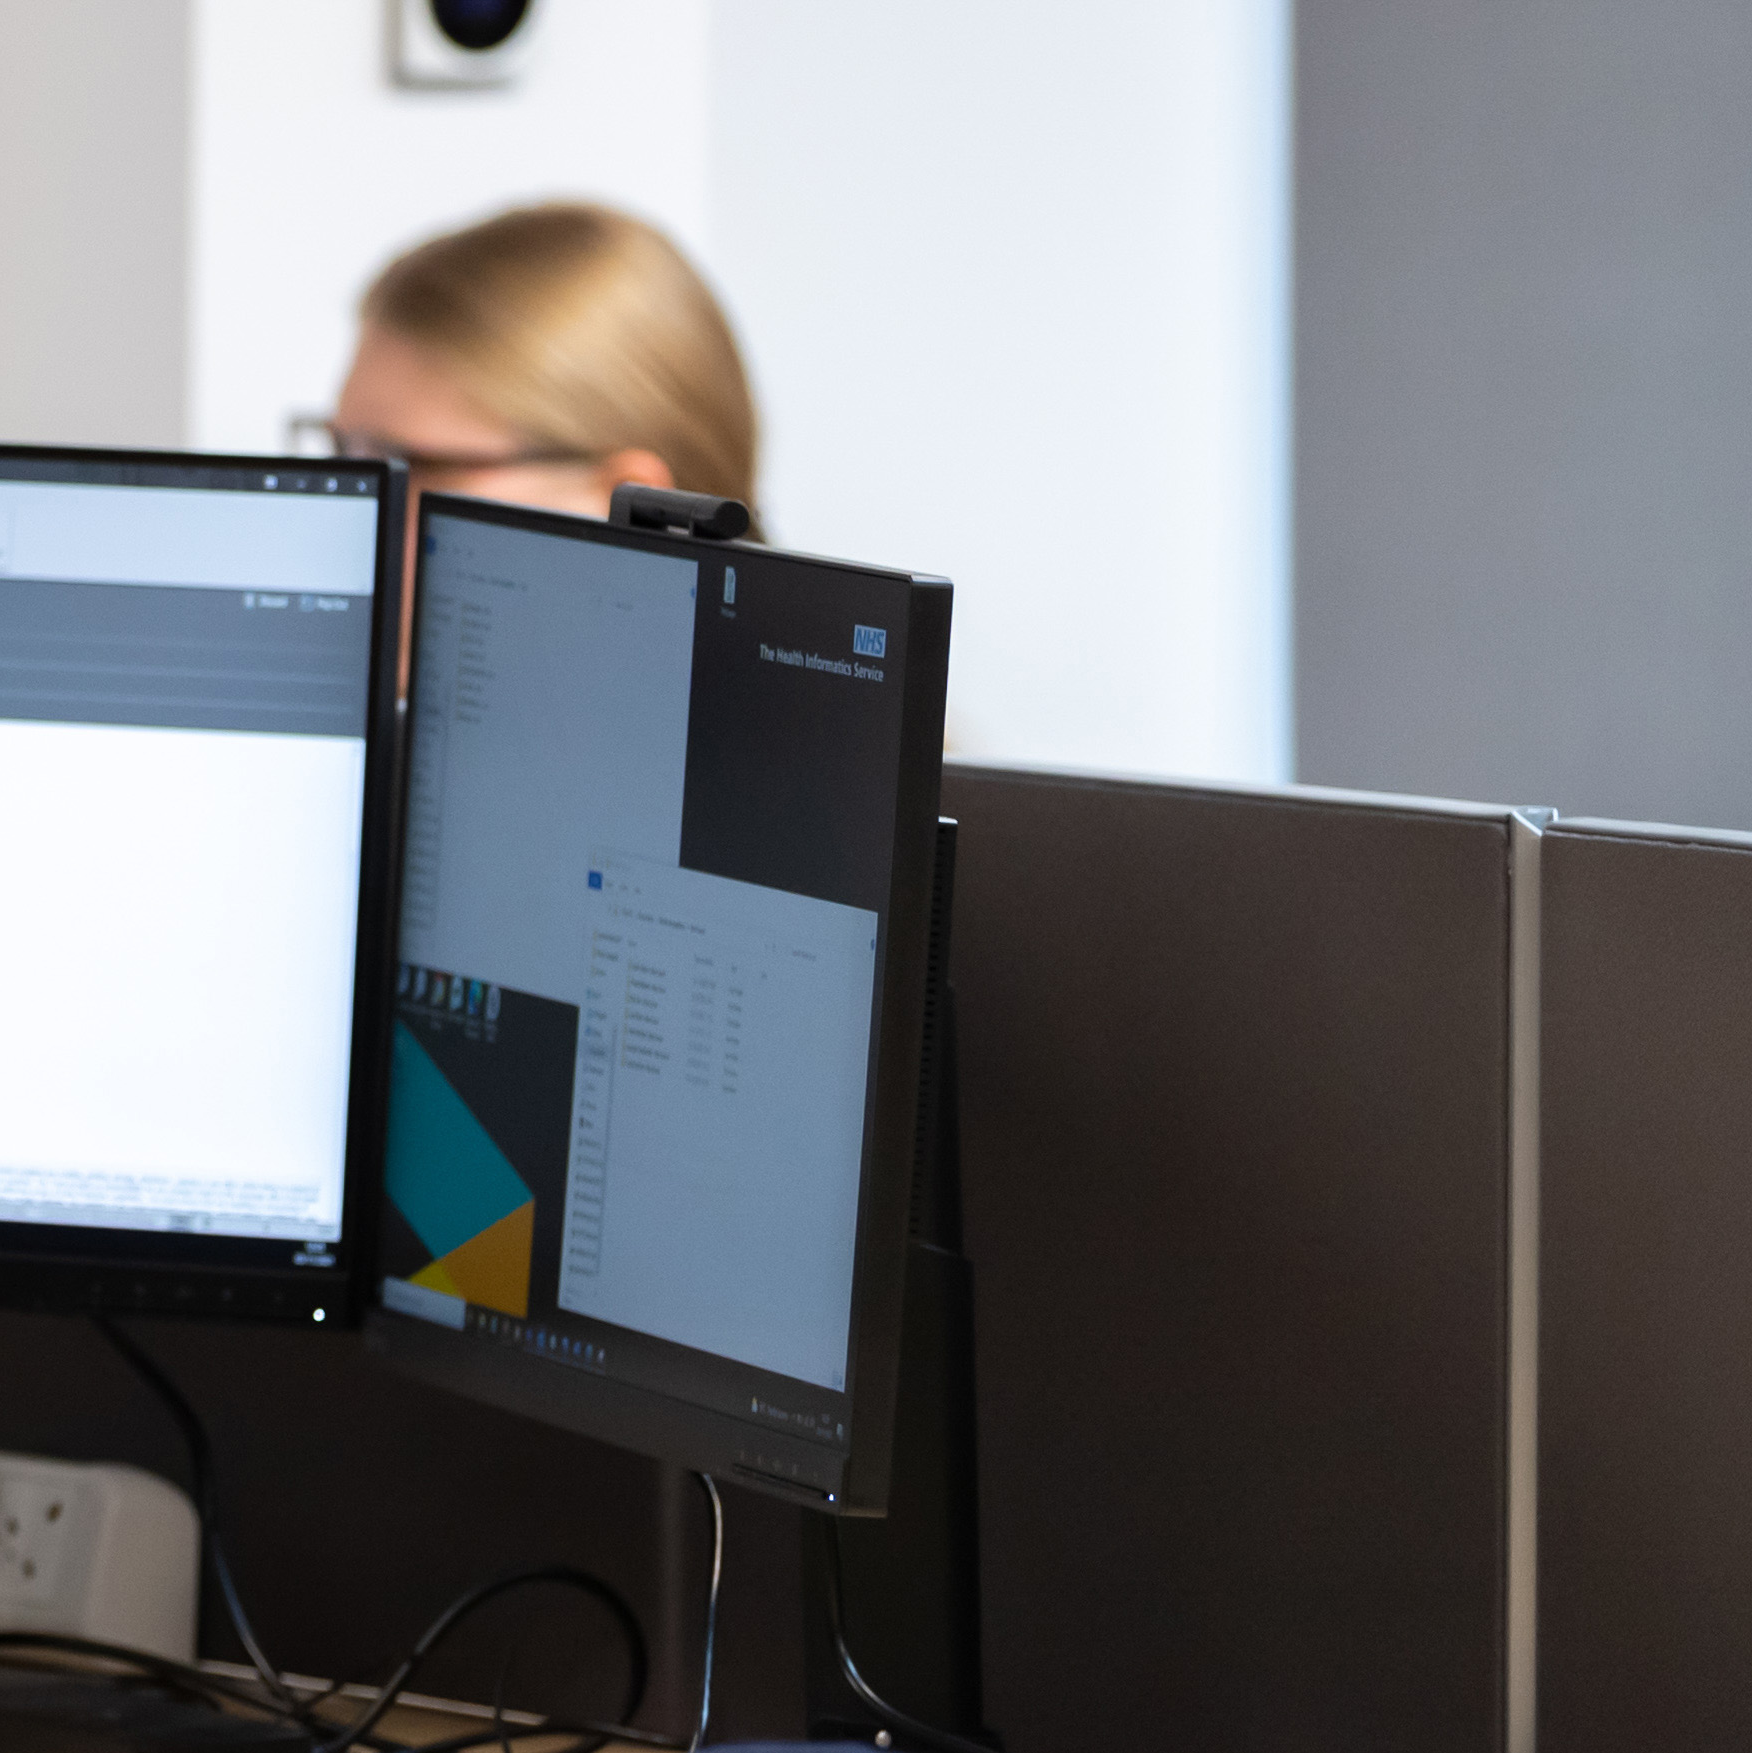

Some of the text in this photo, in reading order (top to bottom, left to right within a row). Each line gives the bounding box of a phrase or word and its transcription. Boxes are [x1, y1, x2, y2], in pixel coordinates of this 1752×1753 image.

[855, 626, 885, 655] NHS
[760, 644, 885, 683] The Health Informatics Service
